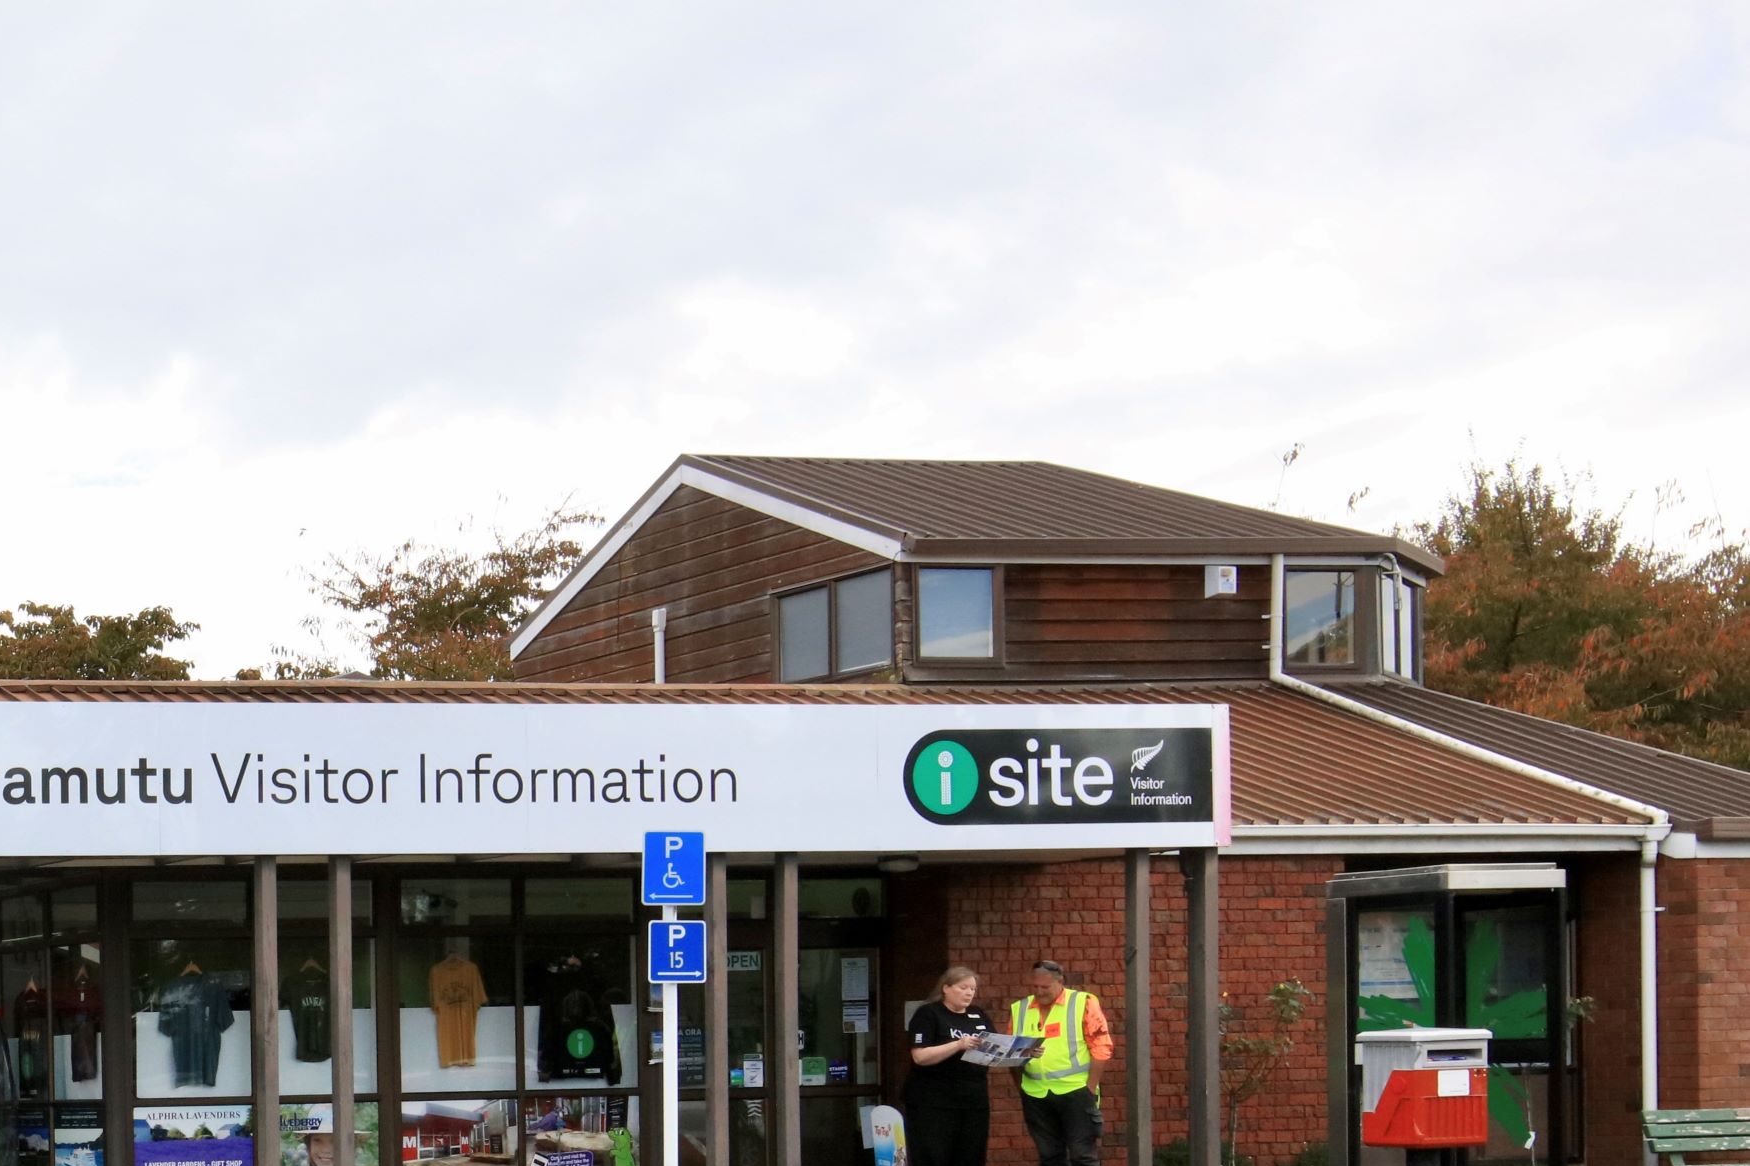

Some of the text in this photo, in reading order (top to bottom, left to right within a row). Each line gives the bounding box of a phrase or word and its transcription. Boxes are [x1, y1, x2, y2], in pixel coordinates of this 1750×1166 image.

[210, 753, 399, 805] Visitor
[420, 753, 738, 805] Information
[988, 738, 1114, 807] site
[1130, 777, 1165, 790] Visitor
[1130, 793, 1192, 806] Information
[665, 836, 683, 858] P
[668, 925, 686, 947] P
[669, 952, 684, 969] 15
[727, 954, 759, 967] PEN
[147, 1111, 241, 1120] ALPHRA LAVENDERS
